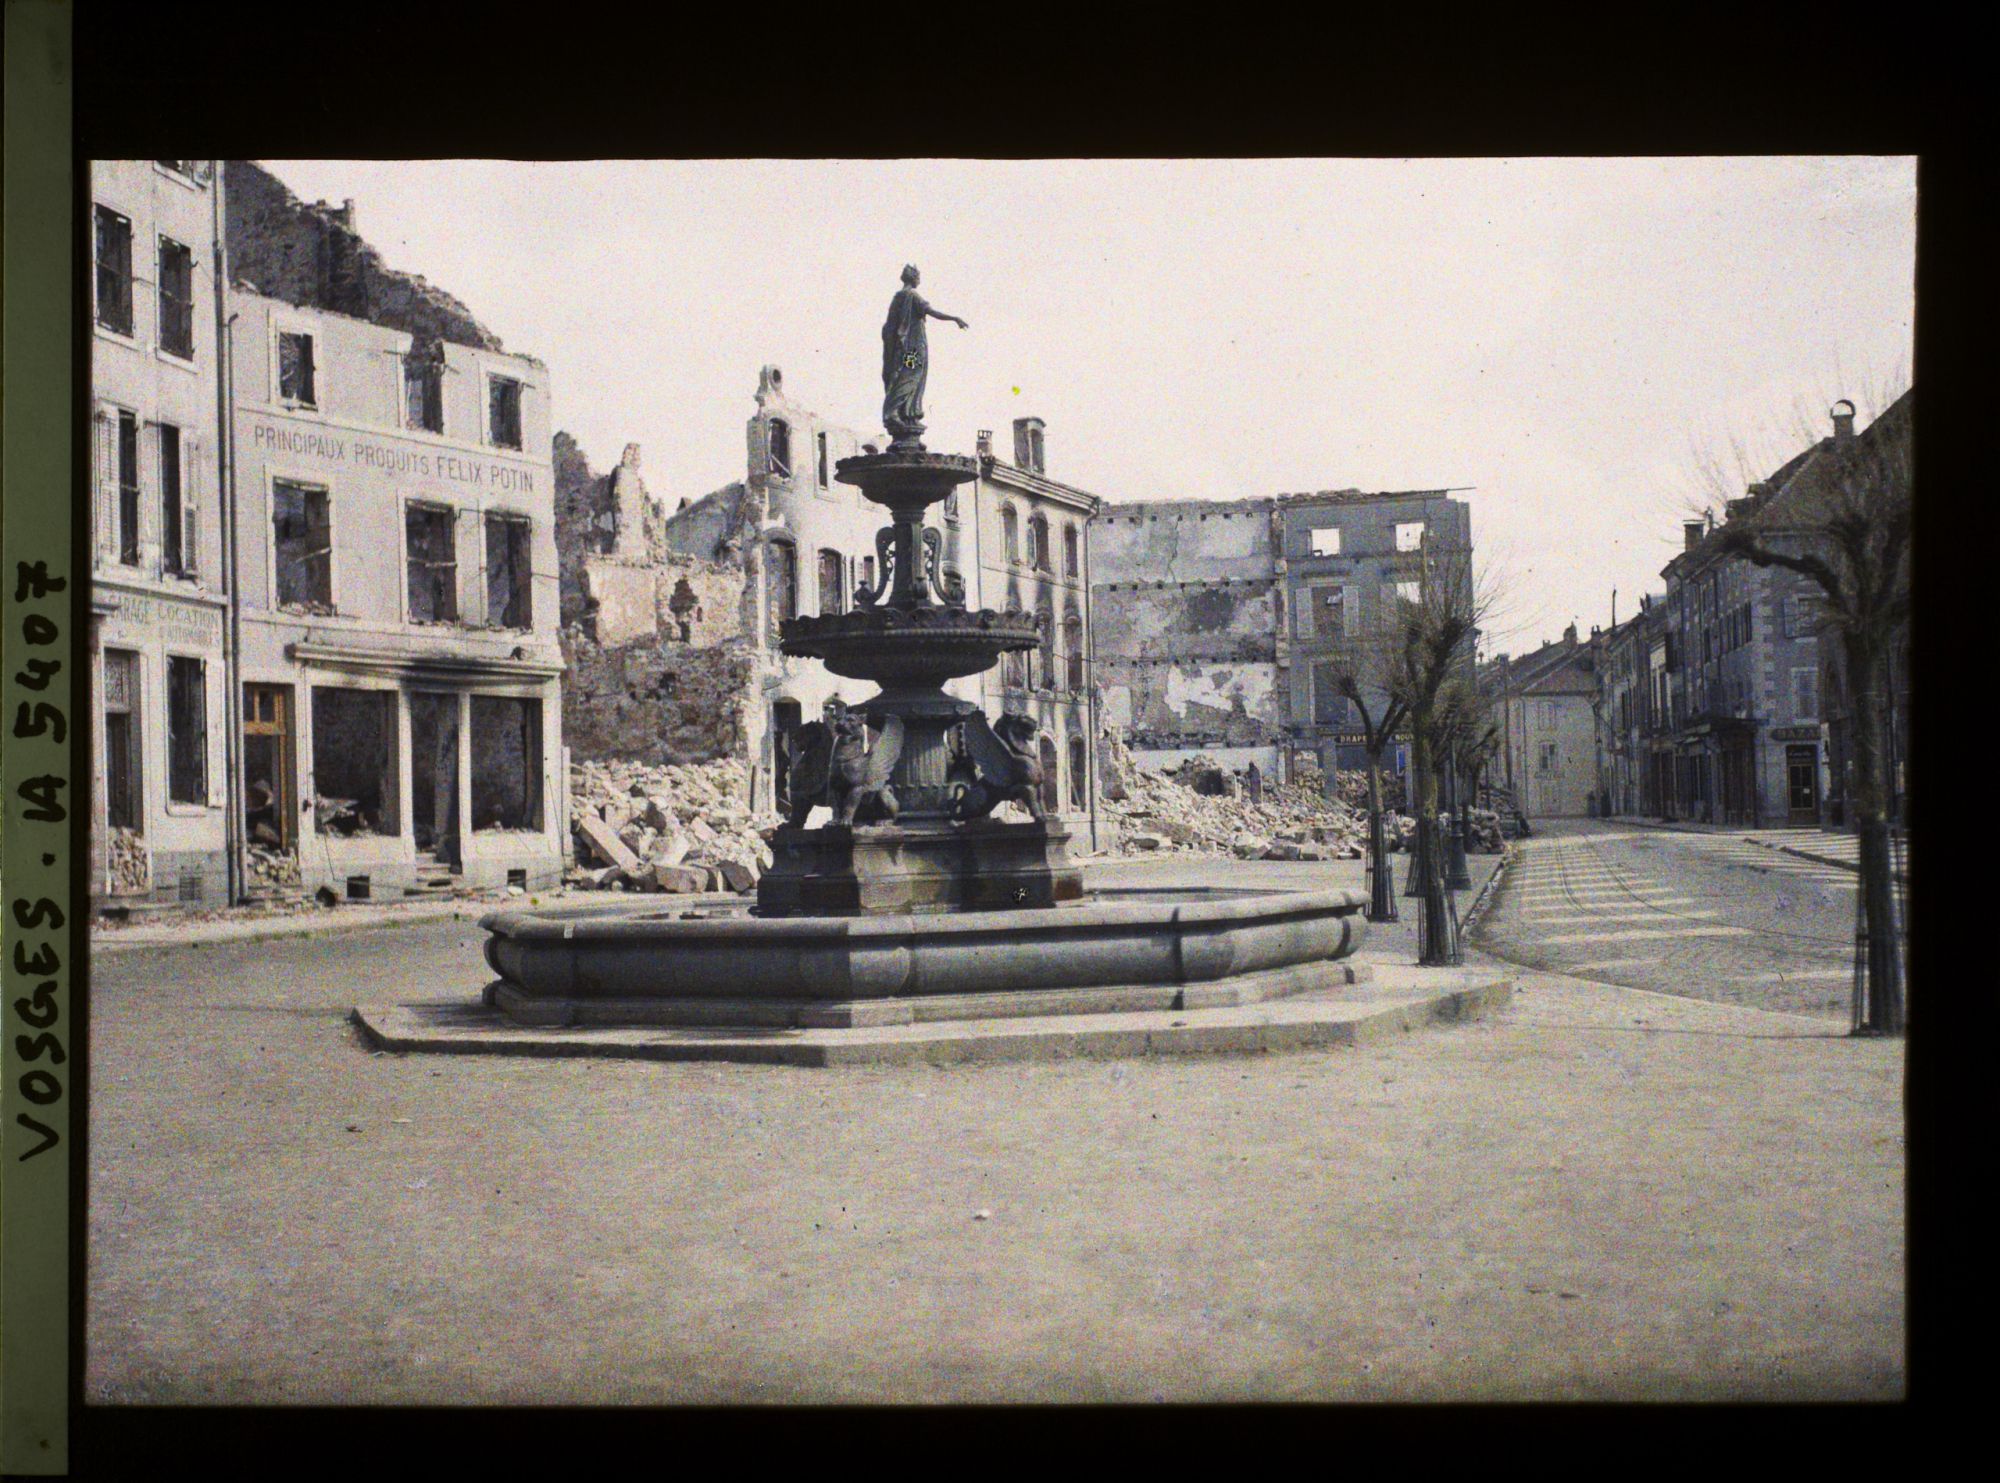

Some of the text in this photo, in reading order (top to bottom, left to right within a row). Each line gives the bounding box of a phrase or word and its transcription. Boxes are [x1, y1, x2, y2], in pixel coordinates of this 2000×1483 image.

[254, 425, 534, 493] PRINCIPAUX PRODUITS FELIX POTIN
[13, 561, 66, 744] 5407
[11, 898, 66, 1162] VOSGES
